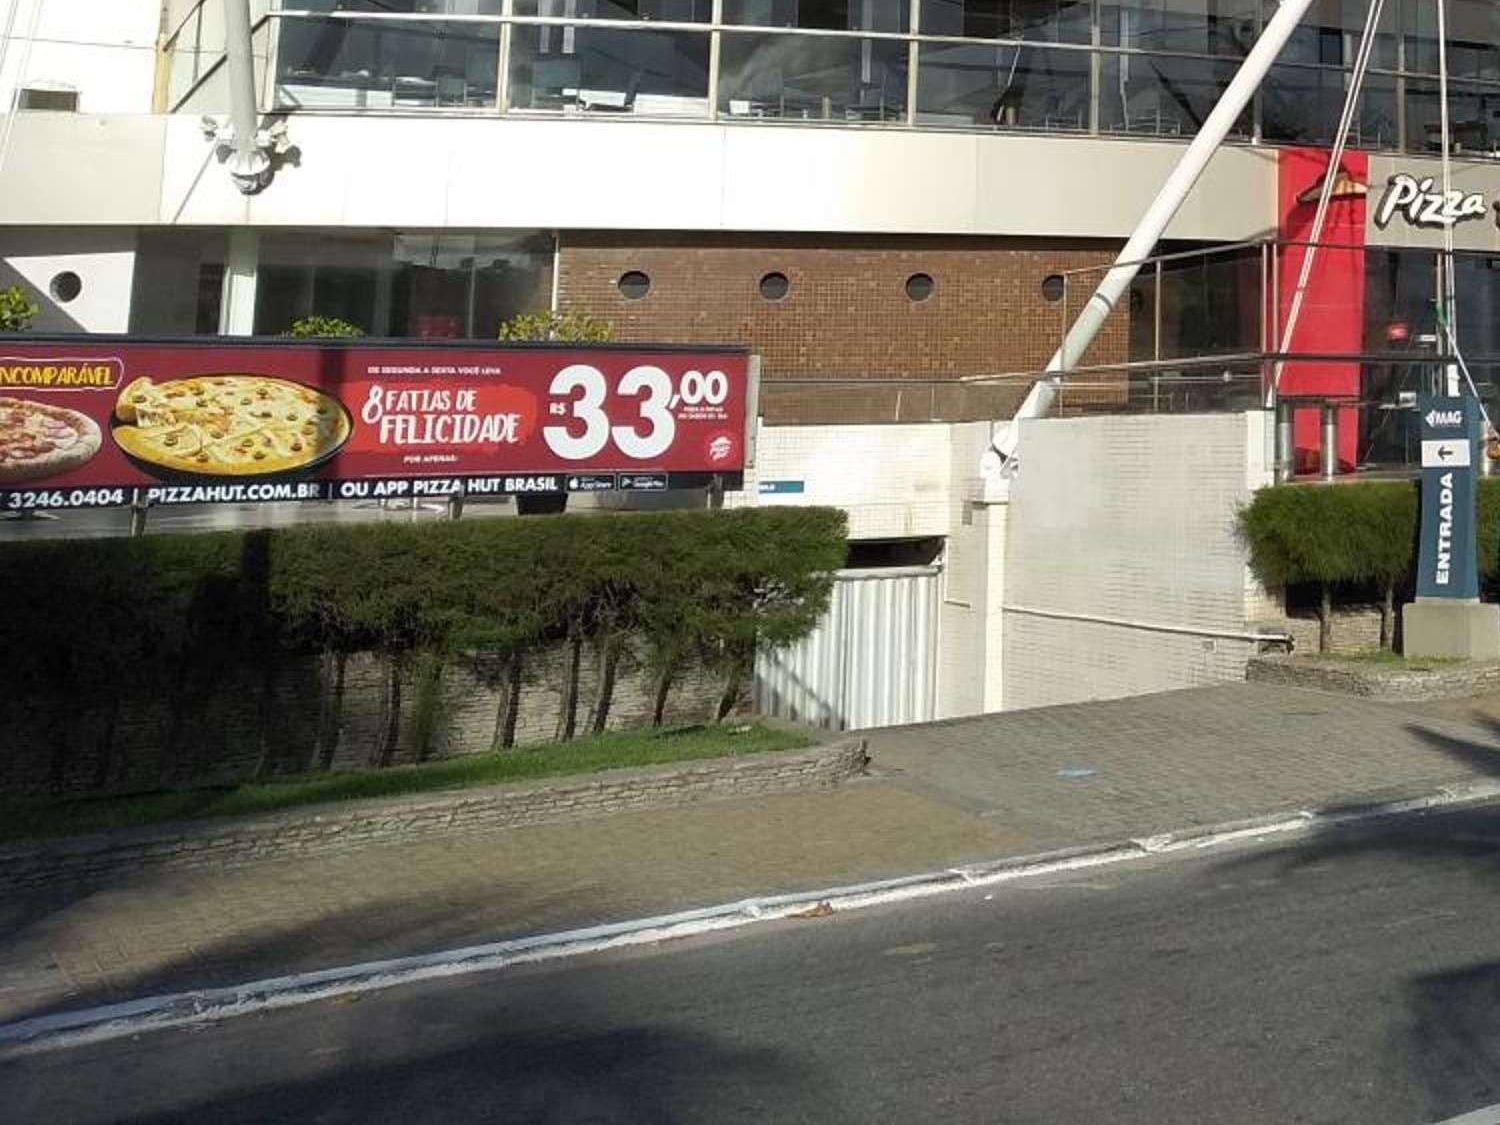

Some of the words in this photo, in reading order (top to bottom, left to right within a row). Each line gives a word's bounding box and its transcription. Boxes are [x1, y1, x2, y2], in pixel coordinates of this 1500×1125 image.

[1377, 173, 1487, 227] Pizza
[362, 385, 383, 424] 8
[385, 390, 451, 412] FATIAS
[455, 390, 478, 412] DE
[549, 402, 567, 416] R$
[1434, 410, 1463, 424] MAG
[379, 414, 521, 444] FELICIDADE
[8, 488, 124, 508] 3246.0404
[147, 483, 321, 504] PIZZAHUT.COM.BR
[341, 482, 369, 496] OU
[374, 480, 409, 496] APP
[413, 479, 462, 494] PIZZA
[467, 478, 501, 493] HUT
[505, 477, 559, 492] BRASIL
[1436, 472, 1453, 585] ENTRADA
